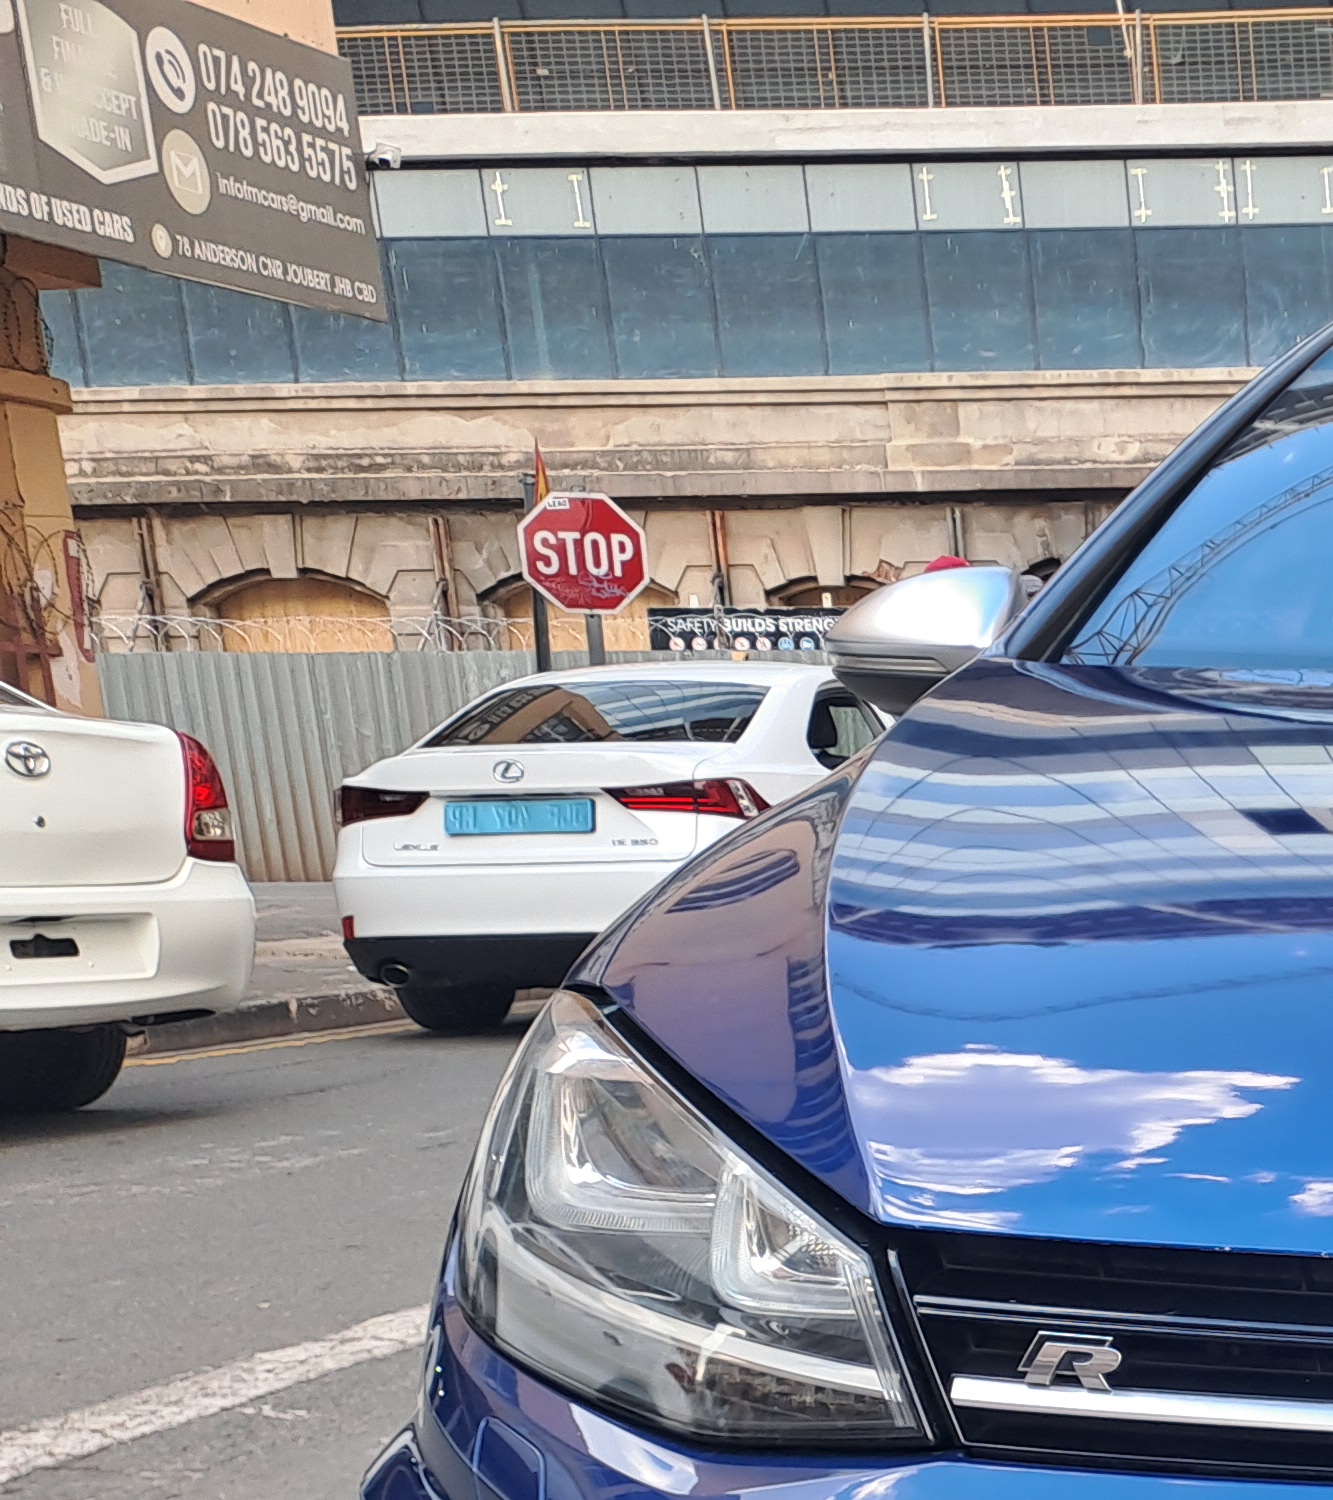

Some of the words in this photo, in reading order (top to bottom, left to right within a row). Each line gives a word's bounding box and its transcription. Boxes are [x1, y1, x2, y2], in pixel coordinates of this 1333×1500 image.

[92, 87, 138, 121] CCEPT
[197, 43, 246, 101] 074
[247, 60, 293, 117] 248
[294, 78, 350, 138] 9094
[206, 101, 254, 158] 078
[254, 116, 300, 173] 563
[301, 132, 358, 191] 5575
[30, 191, 50, 222] OF
[50, 196, 93, 233] USED
[93, 207, 135, 243] CARS
[175, 234, 192, 257] 78
[194, 239, 258, 274] ANDERSON
[258, 255, 285, 281] CNR
[286, 261, 332, 293] JOUBERT
[334, 276, 353, 298] JHB
[354, 281, 377, 304] CBD
[532, 530, 635, 578] STOP
[667, 616, 717, 634] SAFETY
[722, 617, 776, 633] BUILDS
[778, 616, 839, 633] STRENG
[1018, 1330, 1123, 1391] R
